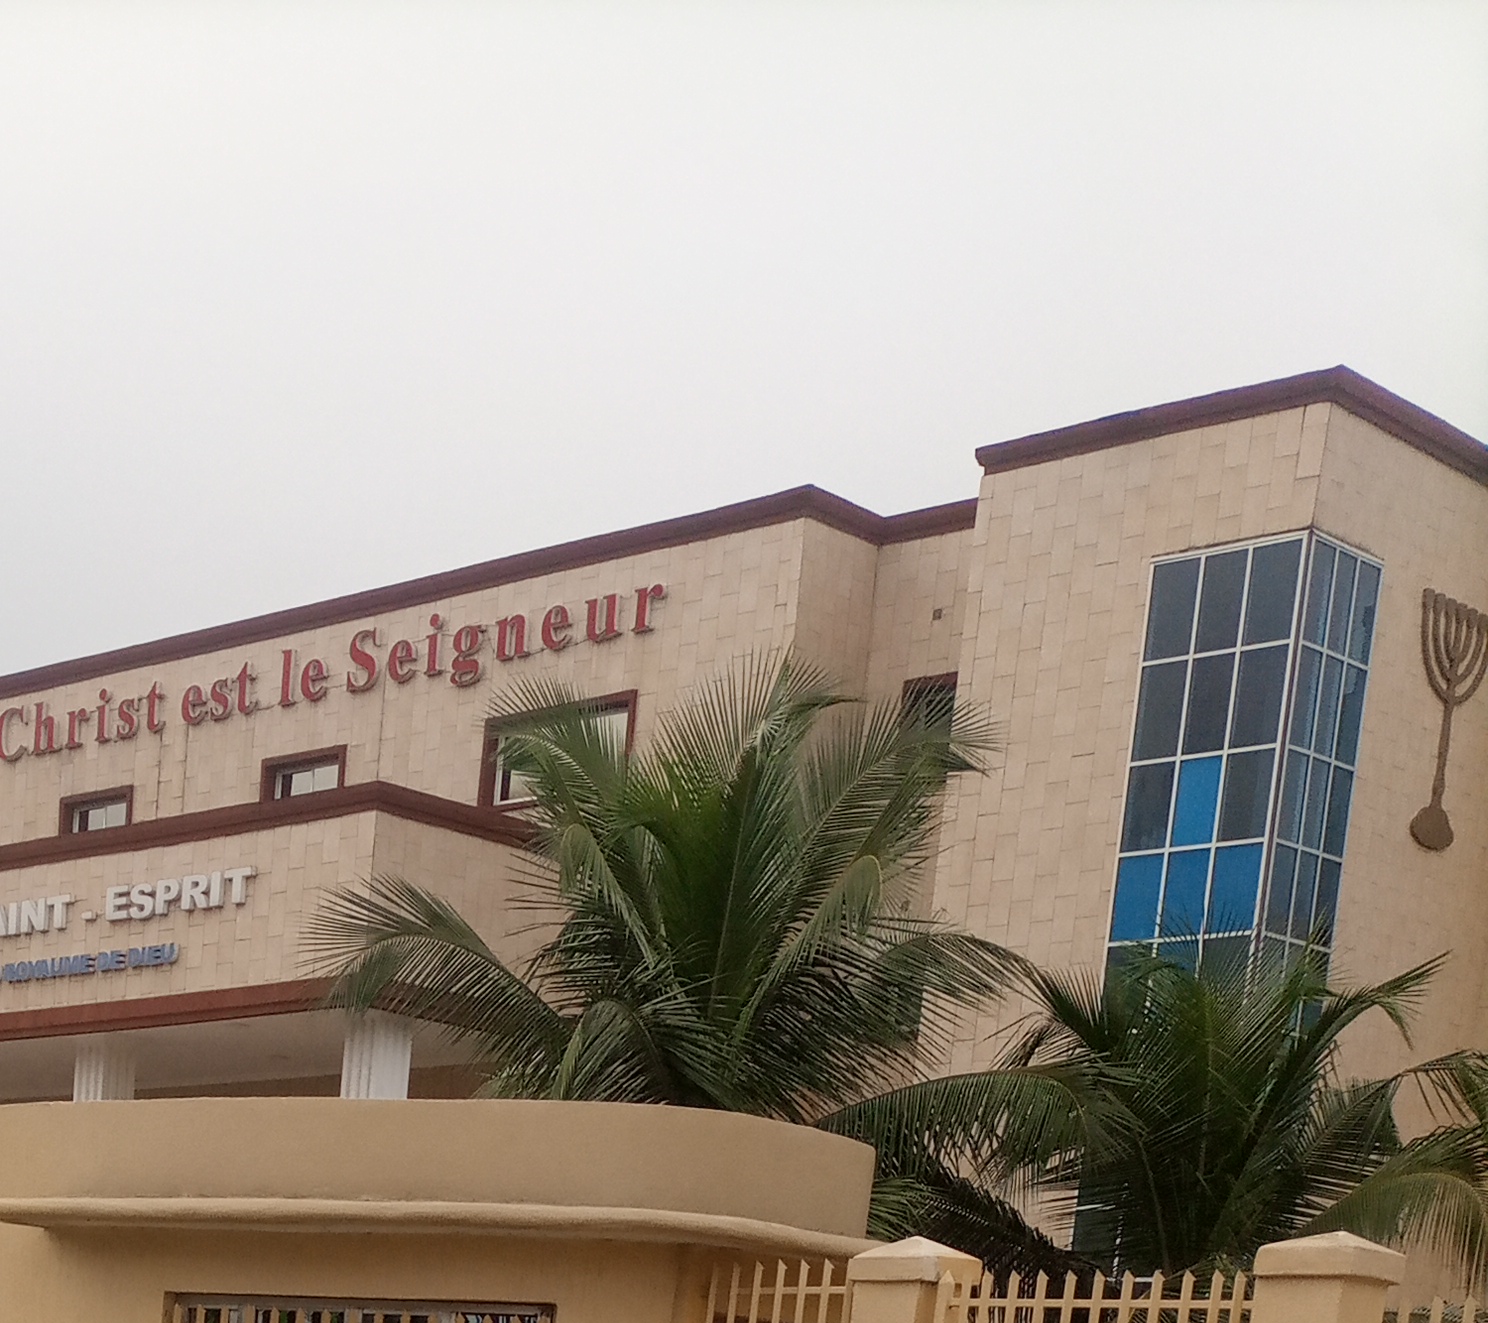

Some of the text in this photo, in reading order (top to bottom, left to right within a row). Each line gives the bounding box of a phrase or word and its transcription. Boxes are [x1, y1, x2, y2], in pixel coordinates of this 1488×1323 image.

[181, 661, 258, 726] est
[277, 648, 329, 703] le
[345, 582, 669, 693] Seigneur
[104, 865, 258, 922] ESPRIT
[96, 950, 127, 973] DE
